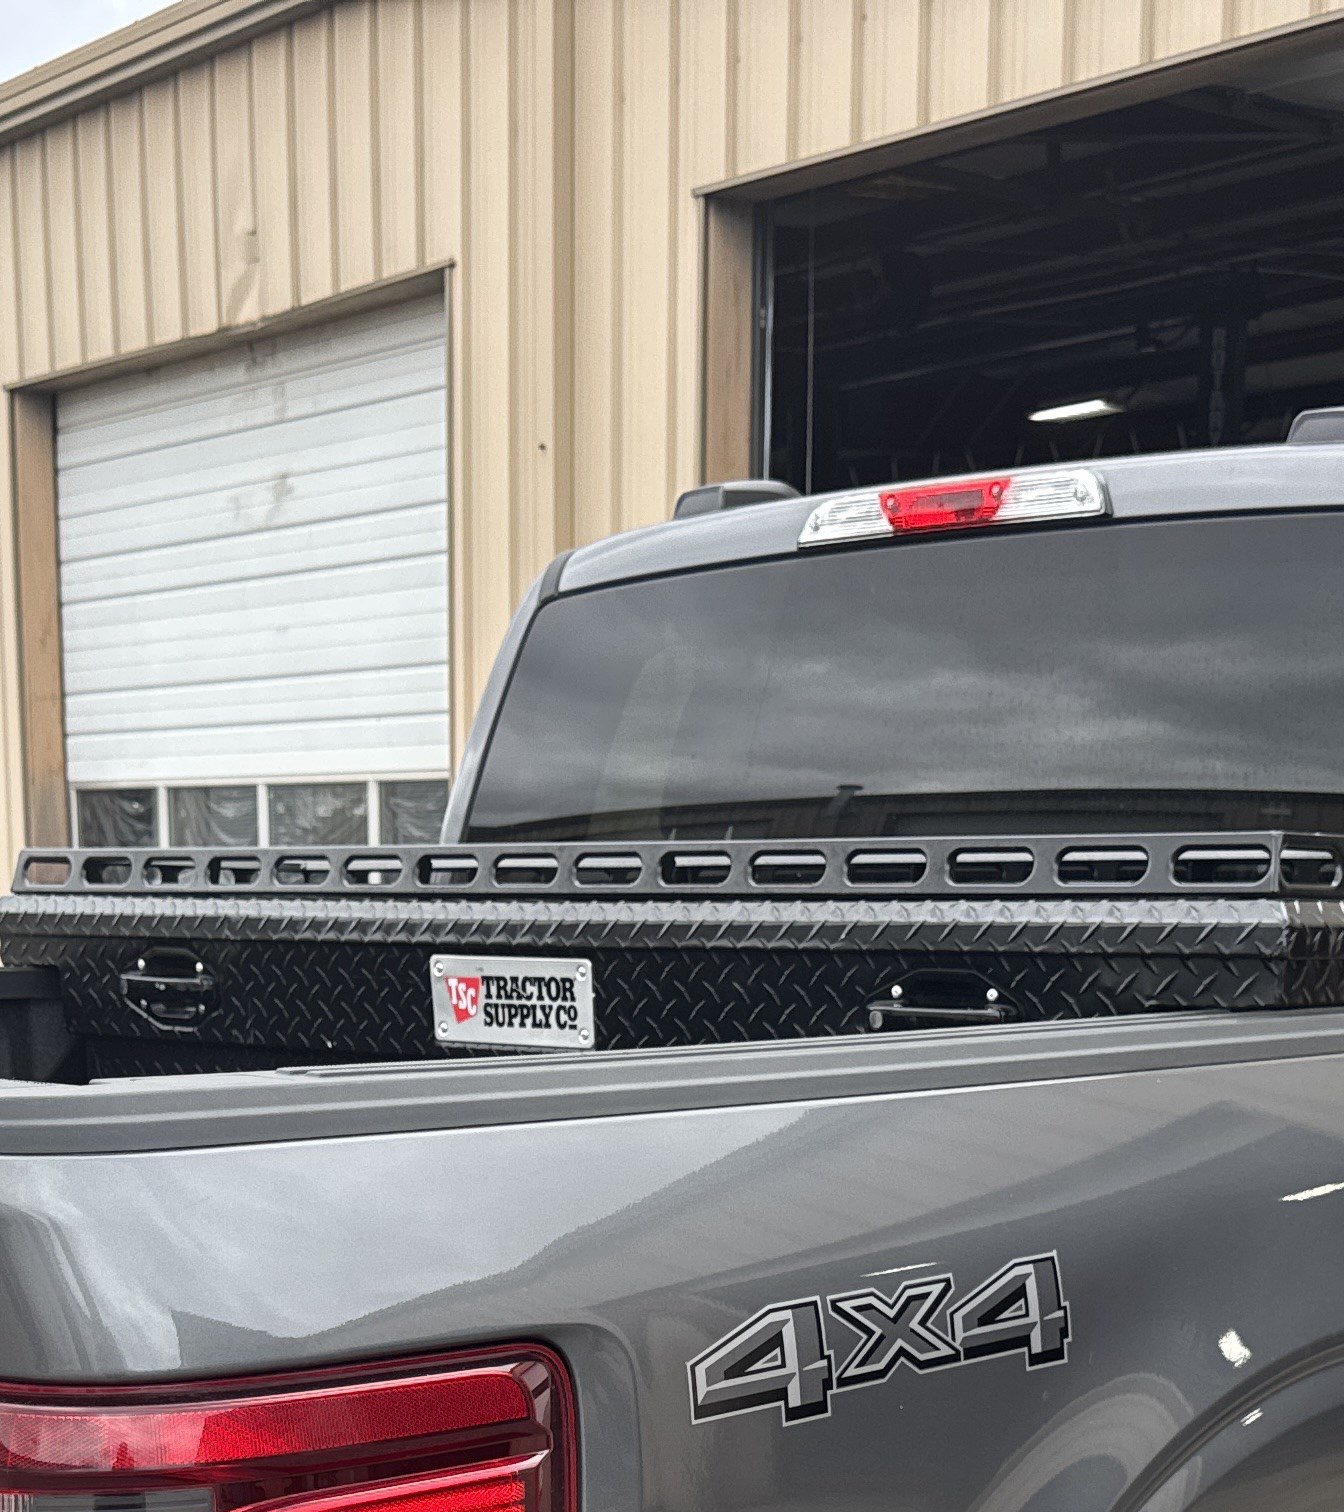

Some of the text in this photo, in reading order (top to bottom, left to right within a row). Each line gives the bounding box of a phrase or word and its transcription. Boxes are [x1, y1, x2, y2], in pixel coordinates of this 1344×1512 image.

[447, 977, 478, 1016] TSC
[481, 975, 577, 1003] TRACTOR
[483, 1002, 554, 1029] SUPPLY
